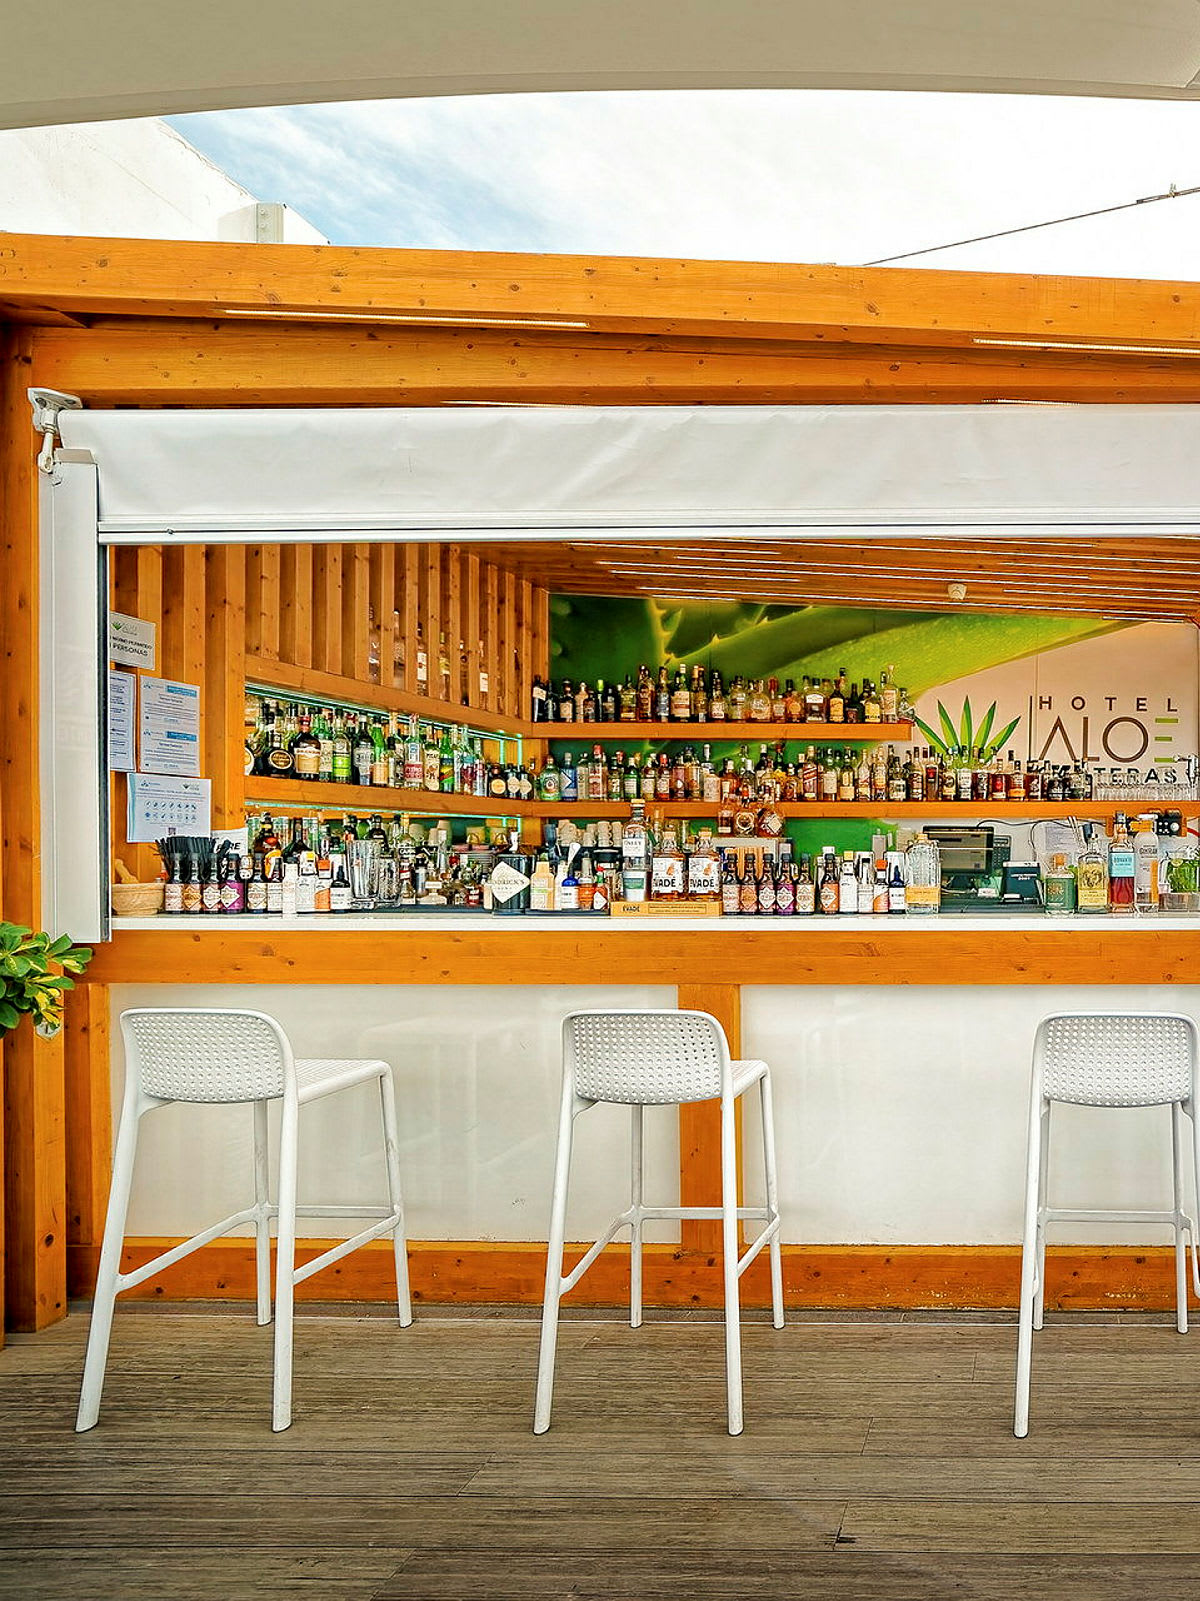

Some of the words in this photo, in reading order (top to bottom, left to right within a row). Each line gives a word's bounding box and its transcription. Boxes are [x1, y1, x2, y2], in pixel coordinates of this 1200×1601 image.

[112, 643, 148, 656] PERSONAS
[1039, 695, 1178, 712] HOTEL
[1038, 715, 1179, 763] ALOE
